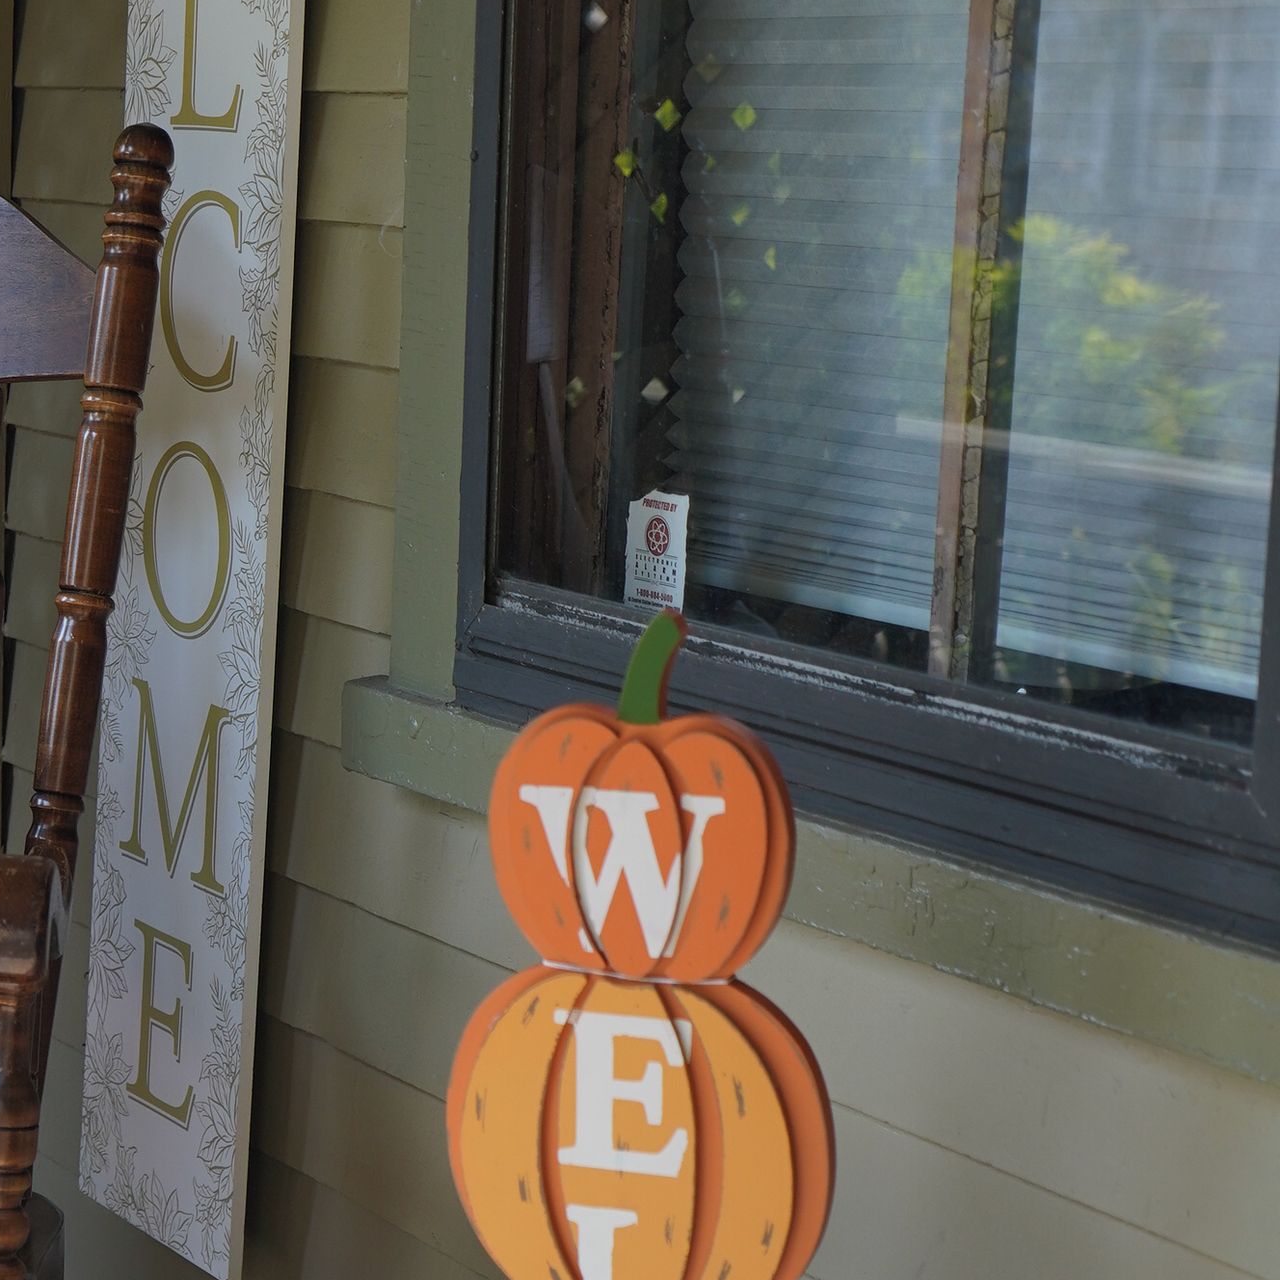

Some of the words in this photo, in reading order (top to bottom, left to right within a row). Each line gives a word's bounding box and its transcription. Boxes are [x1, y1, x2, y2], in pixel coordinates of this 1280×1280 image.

[642, 497, 670, 512] PROTECTED
[670, 502, 678, 513] BY
[635, 553, 678, 569] ELECTRONIC
[635, 561, 677, 576] ALARM
[634, 568, 677, 584] SYSTEMS
